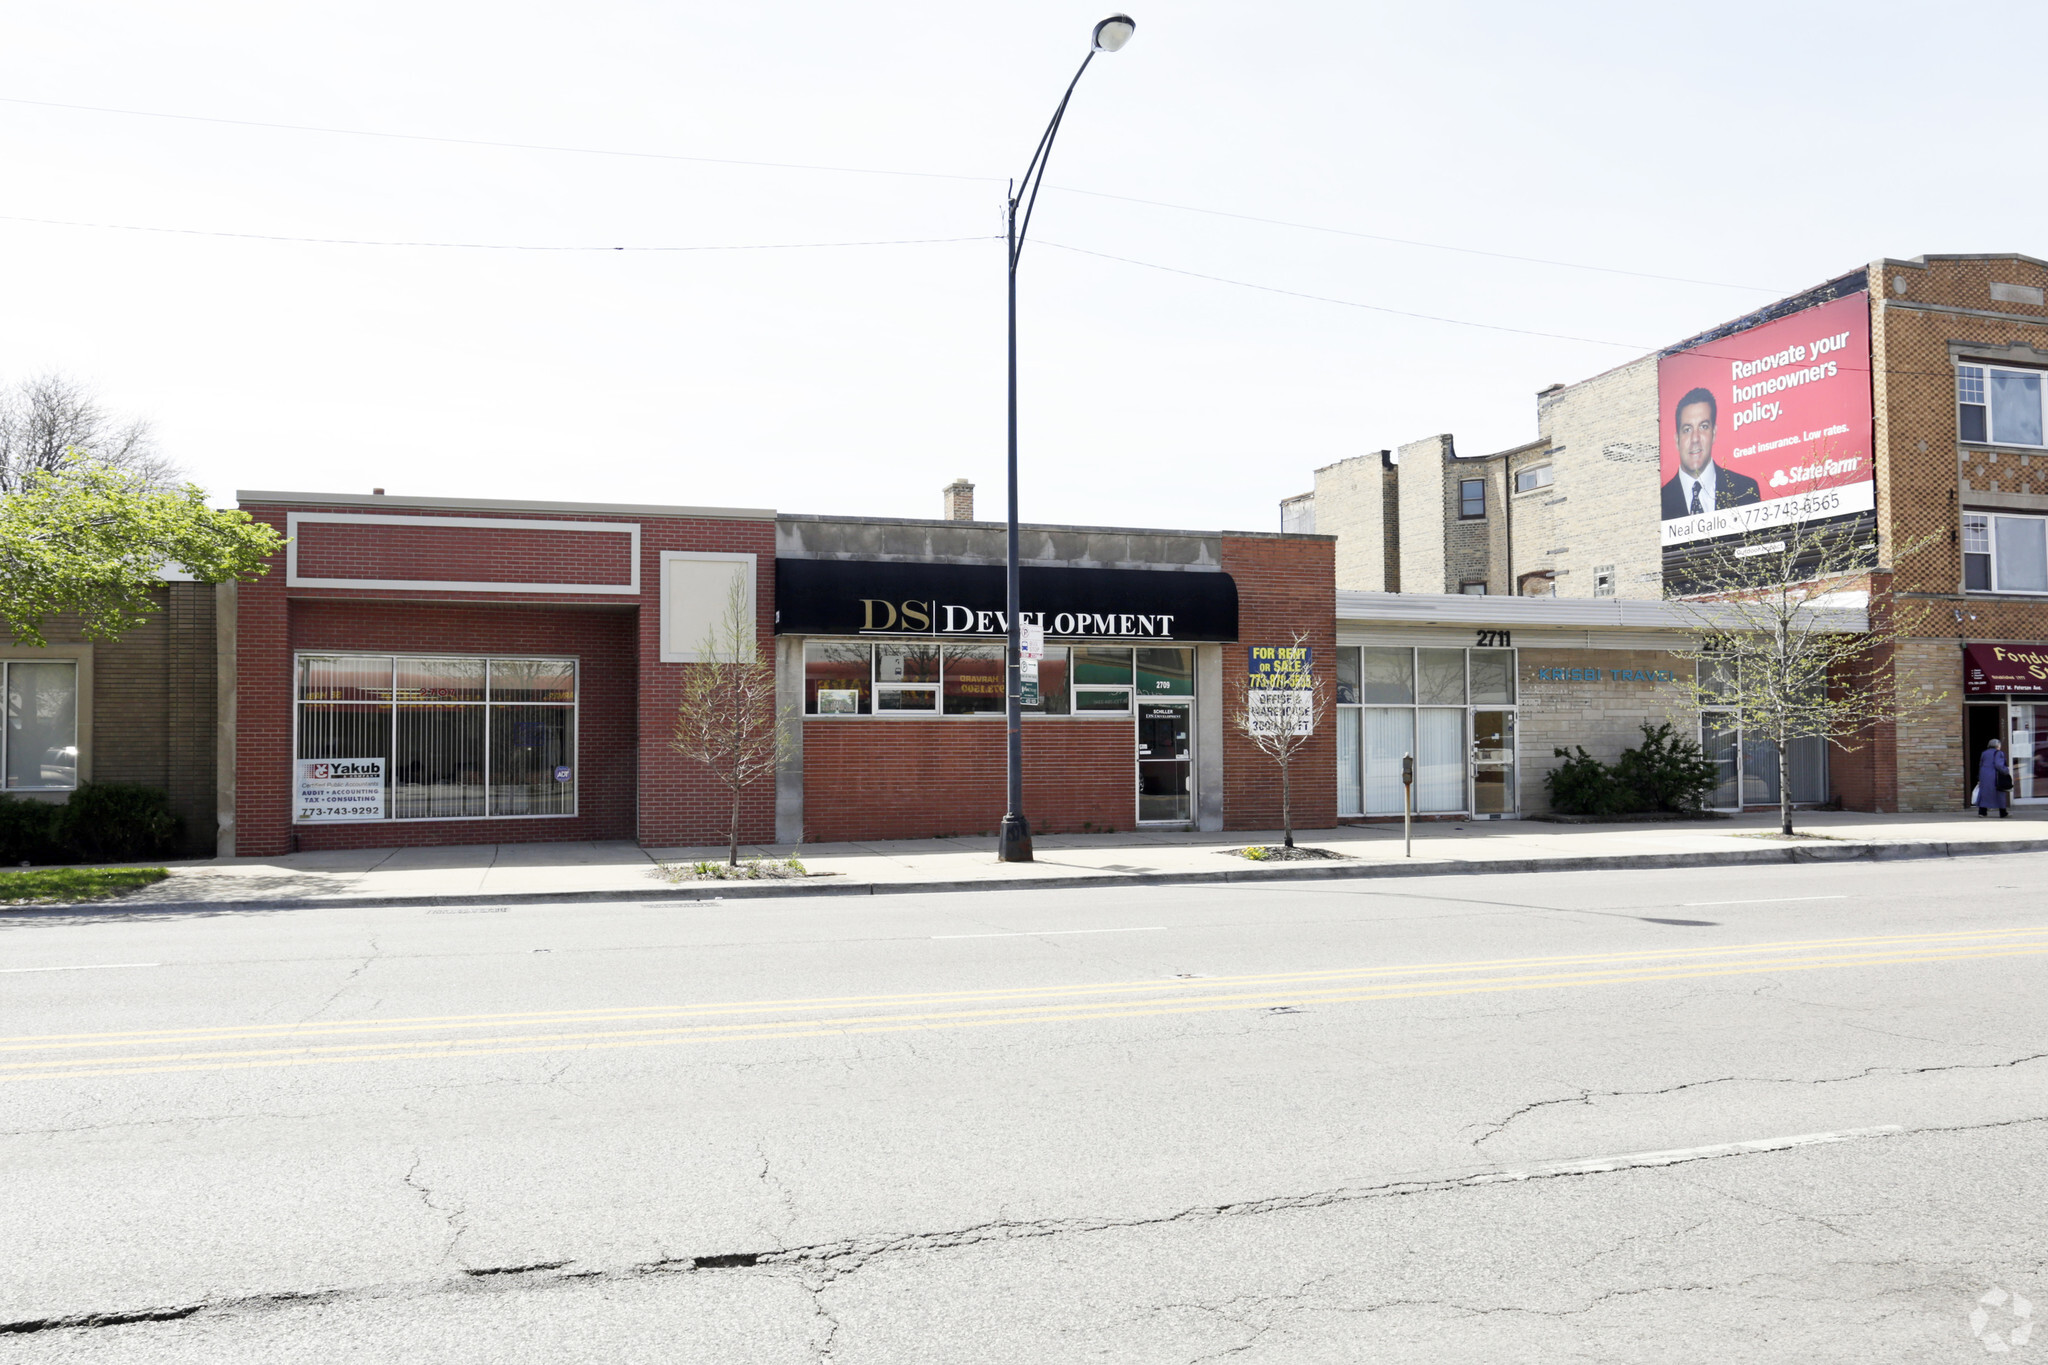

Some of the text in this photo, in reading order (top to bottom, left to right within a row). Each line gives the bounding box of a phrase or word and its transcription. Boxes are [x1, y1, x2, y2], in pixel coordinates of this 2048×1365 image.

[1732, 331, 1850, 381] Renovate your
[1732, 360, 1837, 404] homeowners
[1733, 401, 1783, 431] policy.
[1733, 423, 1850, 458] Great insurance. Low rates.
[1668, 493, 1840, 539] Neal Gallo 773-743-6565
[860, 599, 930, 631] DS
[1476, 629, 1511, 647] 2711
[1252, 647, 1307, 660] FOR RENT
[1259, 660, 1302, 672] OR SALE
[1538, 668, 1601, 681] KRISBI
[1155, 681, 1171, 689] 2709
[419, 687, 456, 698] 2707
[330, 762, 380, 774] Yakub
[345, 780, 379, 788] Accountants
[331, 788, 379, 796] ACCOUNTING
[301, 806, 379, 816] 773-743-9292
